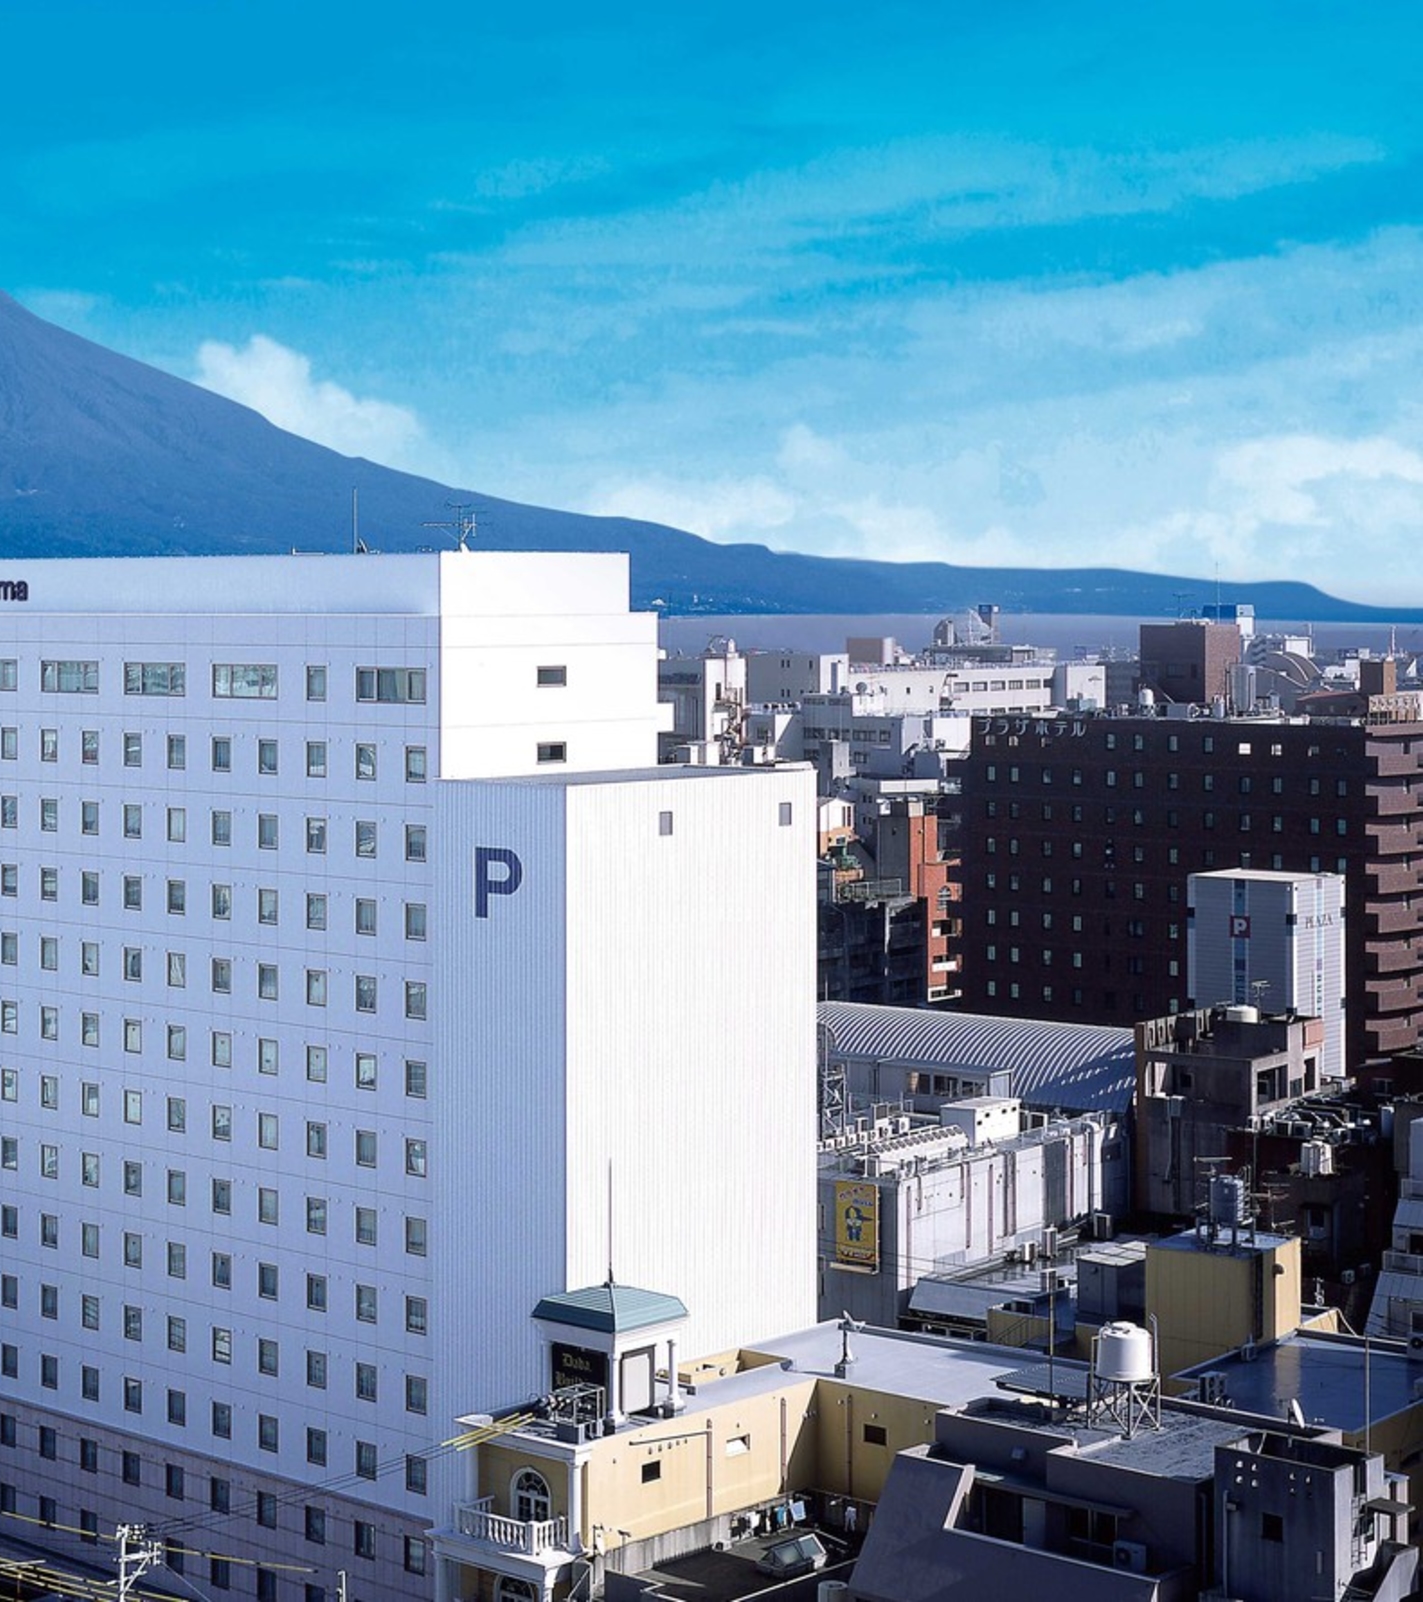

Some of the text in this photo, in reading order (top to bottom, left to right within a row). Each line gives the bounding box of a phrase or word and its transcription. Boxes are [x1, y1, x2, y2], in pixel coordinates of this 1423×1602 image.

[978, 718, 1087, 737] プラザホテル
[475, 846, 523, 919] P
[1233, 917, 1247, 935] P
[1305, 913, 1334, 929] PLAZA
